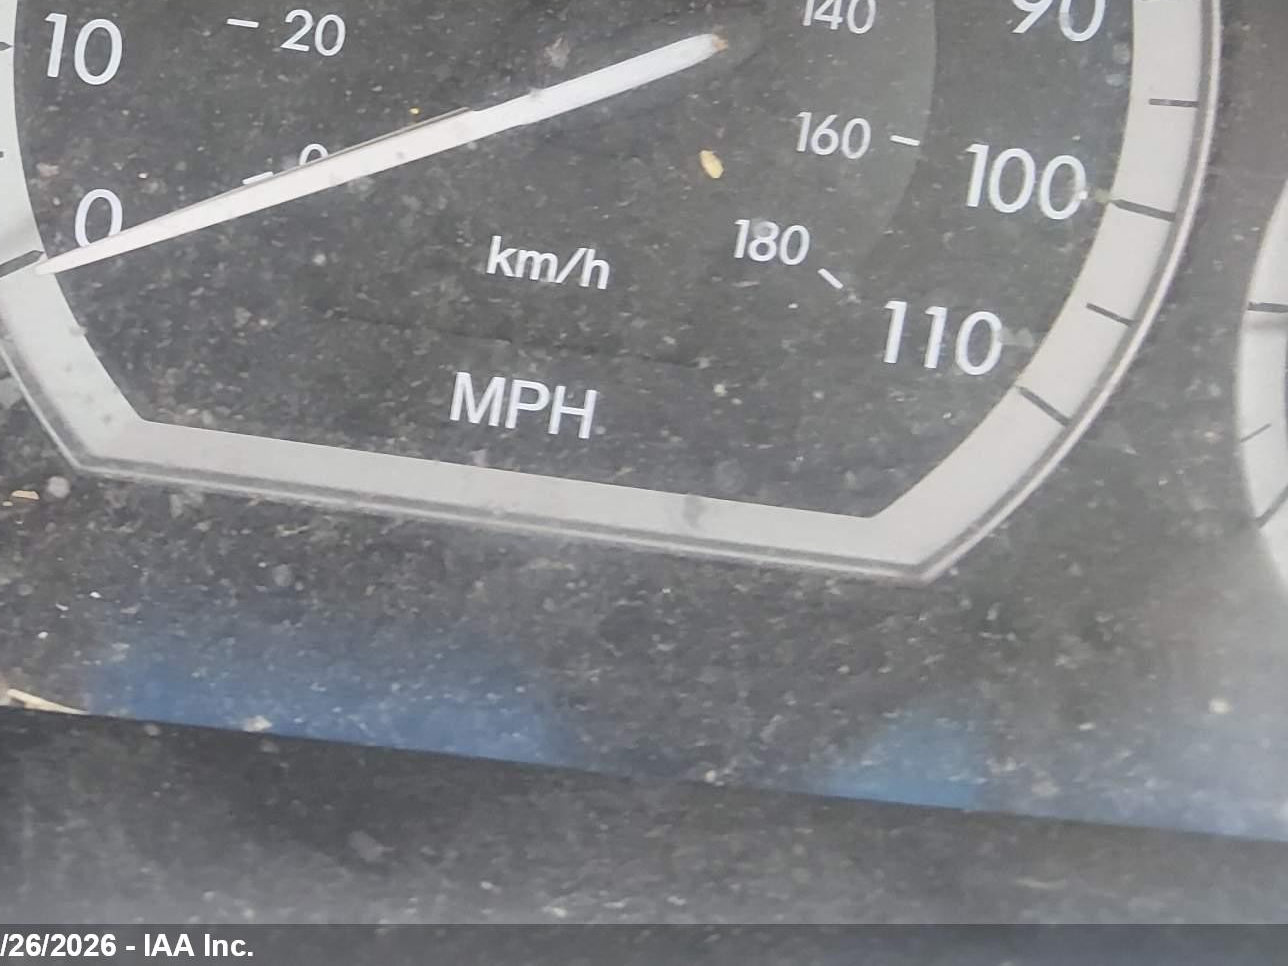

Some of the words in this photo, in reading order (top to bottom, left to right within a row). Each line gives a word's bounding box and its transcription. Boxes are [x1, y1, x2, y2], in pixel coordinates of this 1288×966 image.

[44, 12, 124, 86] 10
[280, 9, 347, 57] 20
[795, 111, 872, 160] 160
[965, 143, 1087, 221] 100
[74, 188, 124, 248] 0
[733, 218, 810, 266] 180
[485, 235, 611, 290] km/h
[883, 300, 1003, 377] 110
[449, 371, 599, 439] MPH
